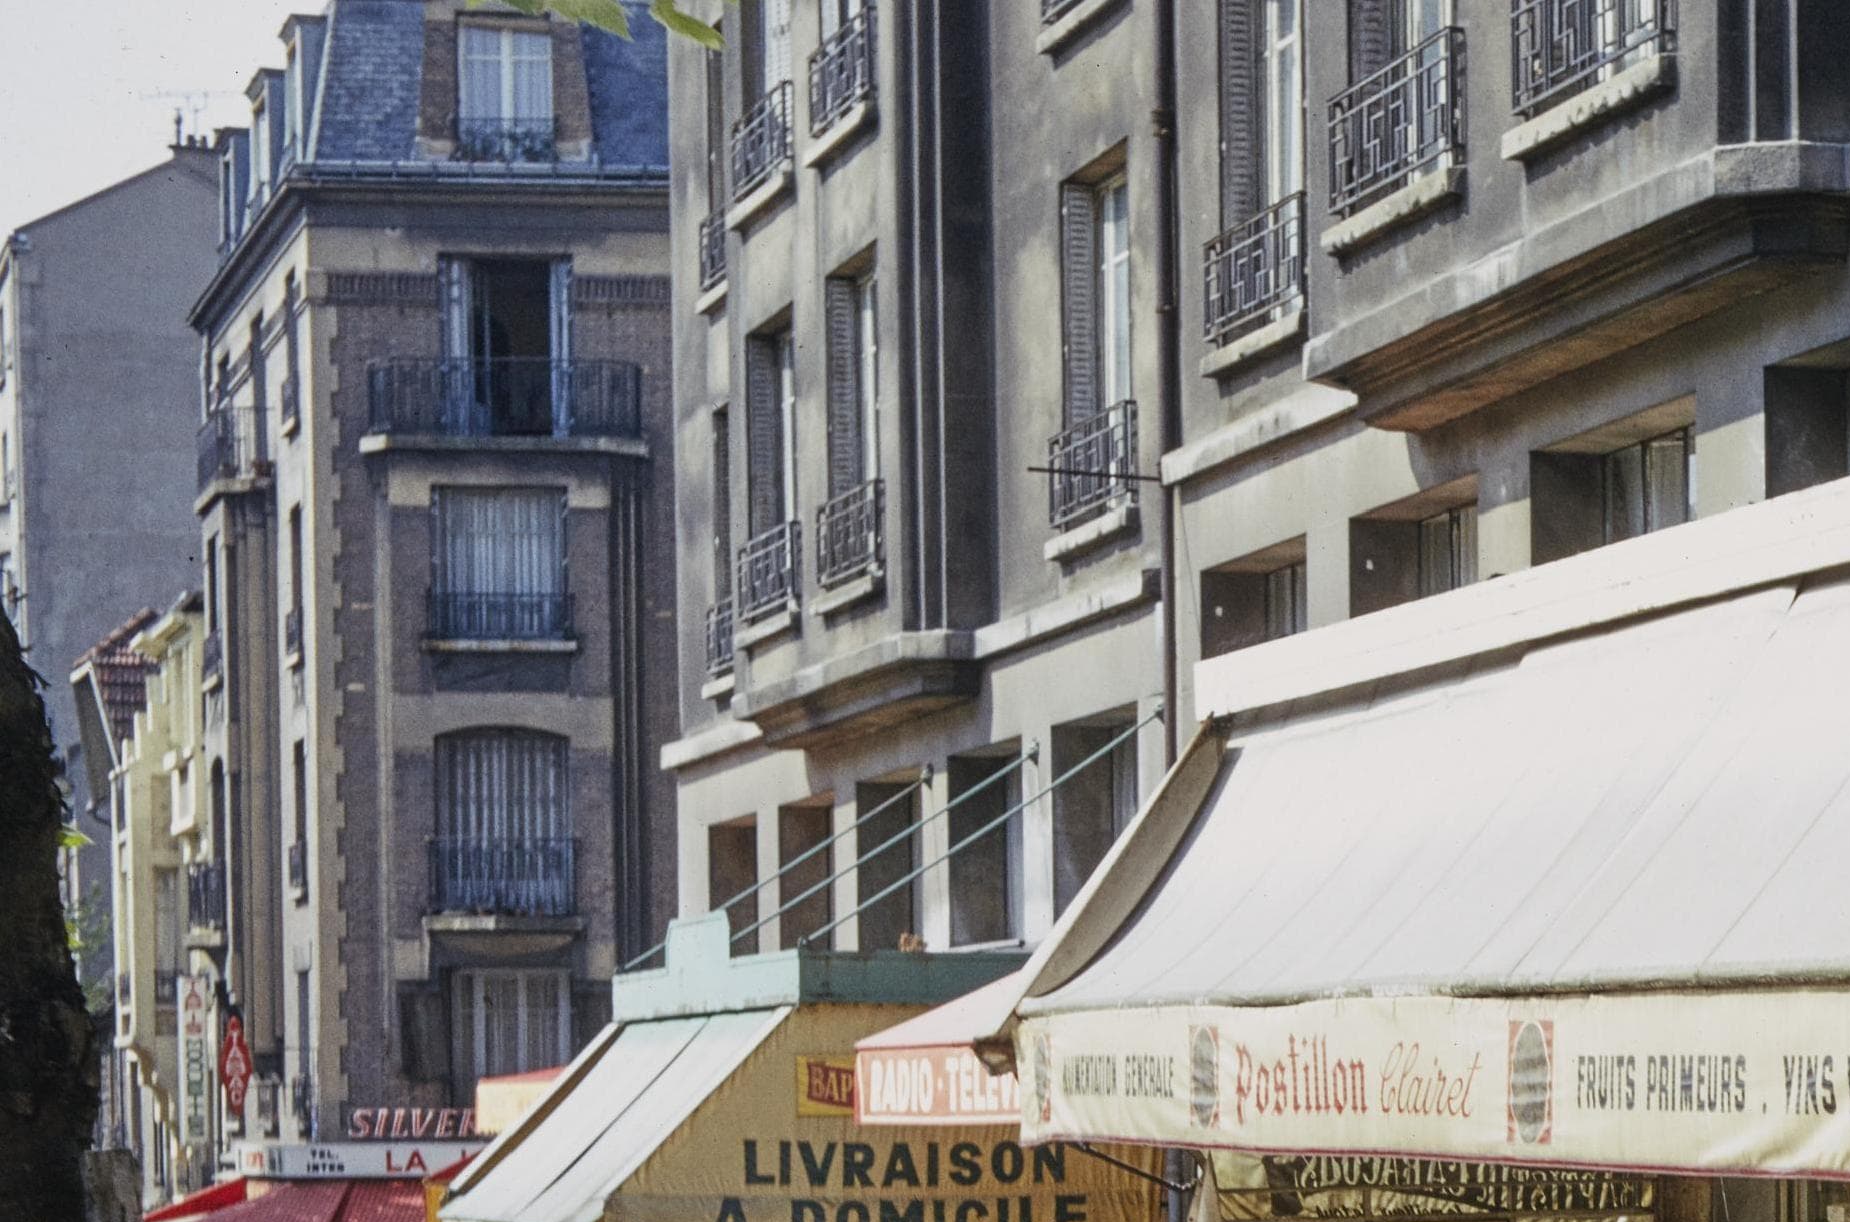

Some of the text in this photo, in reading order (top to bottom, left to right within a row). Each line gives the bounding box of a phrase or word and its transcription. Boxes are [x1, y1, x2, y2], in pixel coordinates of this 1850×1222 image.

[869, 1057, 934, 1114] RADIO
[1235, 1033, 1483, 1126] Postillon Clairet
[1576, 1054, 1637, 1111] FRUITS
[1646, 1054, 1748, 1114] PRIMEURS
[1783, 1055, 1838, 1116] VINS
[743, 1140, 1066, 1188] LIVRAISON
